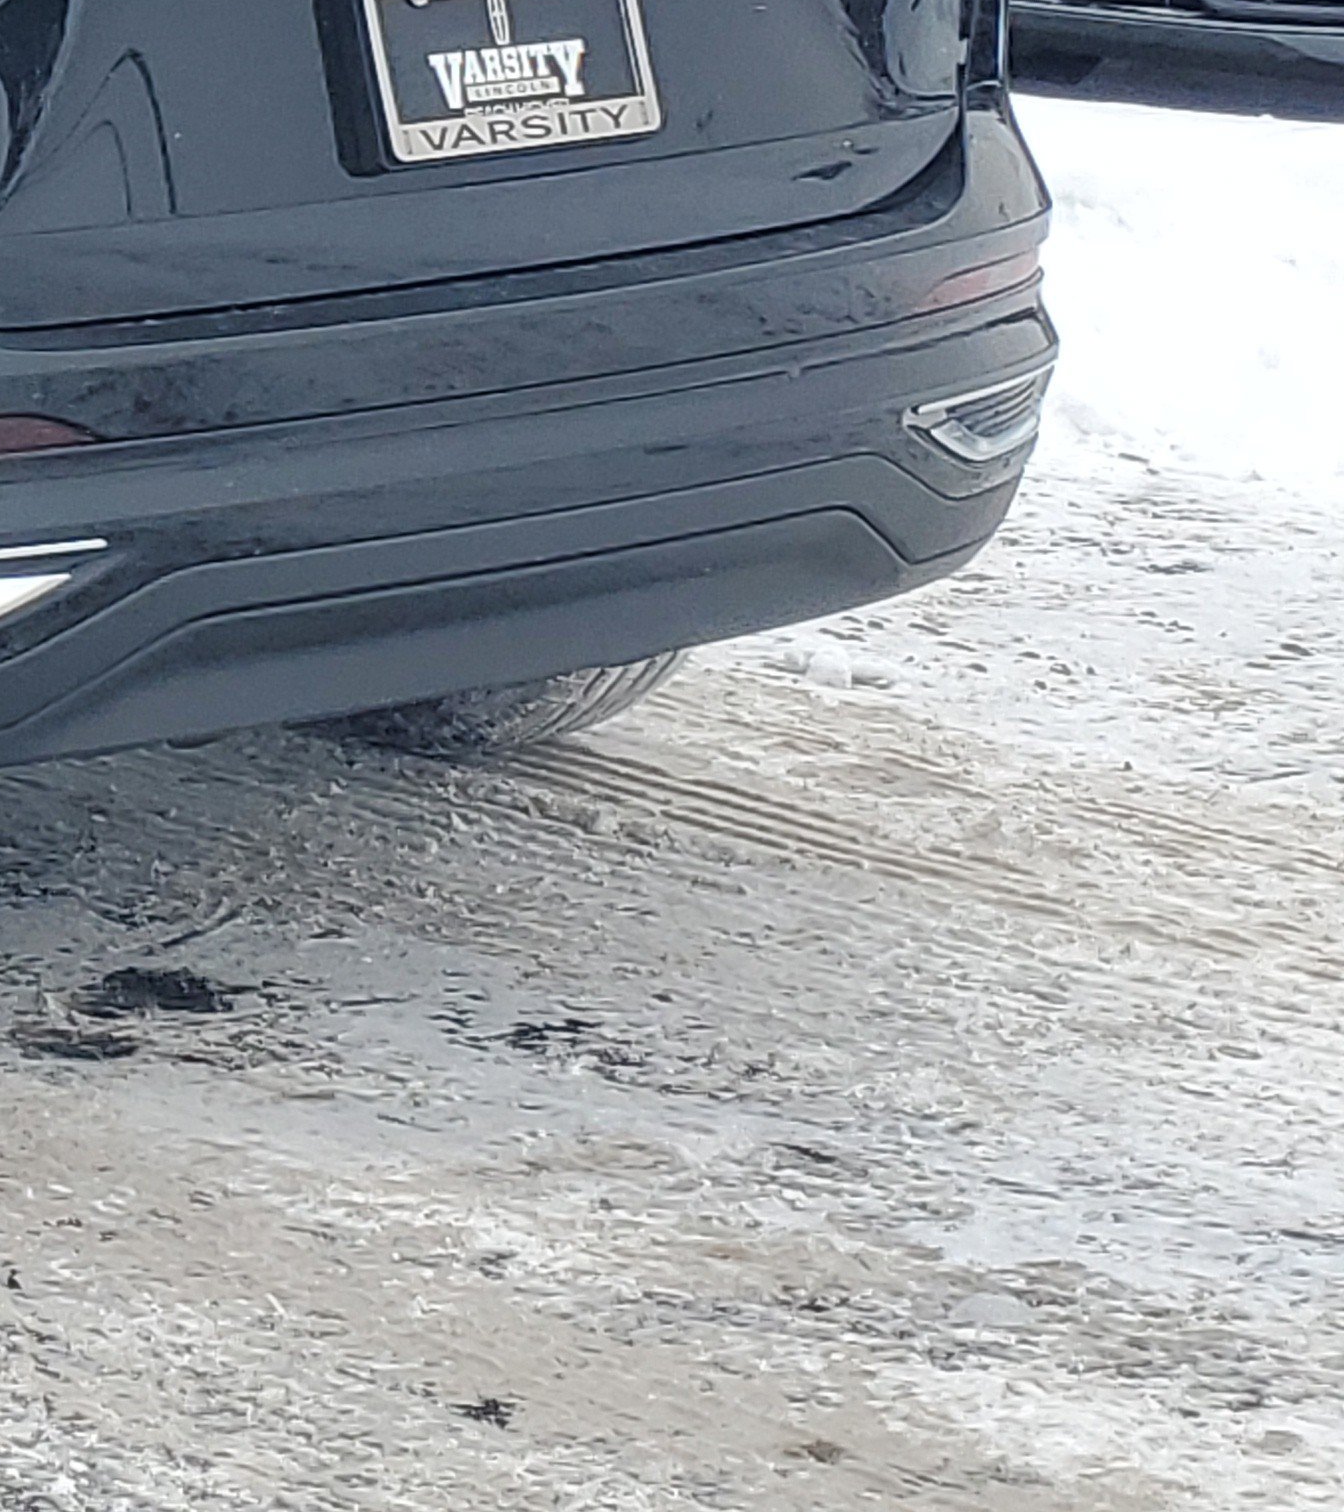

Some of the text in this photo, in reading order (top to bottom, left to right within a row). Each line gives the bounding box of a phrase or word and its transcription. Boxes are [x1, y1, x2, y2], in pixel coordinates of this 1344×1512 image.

[427, 38, 586, 110] VARSITY
[473, 80, 551, 99] LINCOLN
[419, 104, 629, 152] VARSITY
